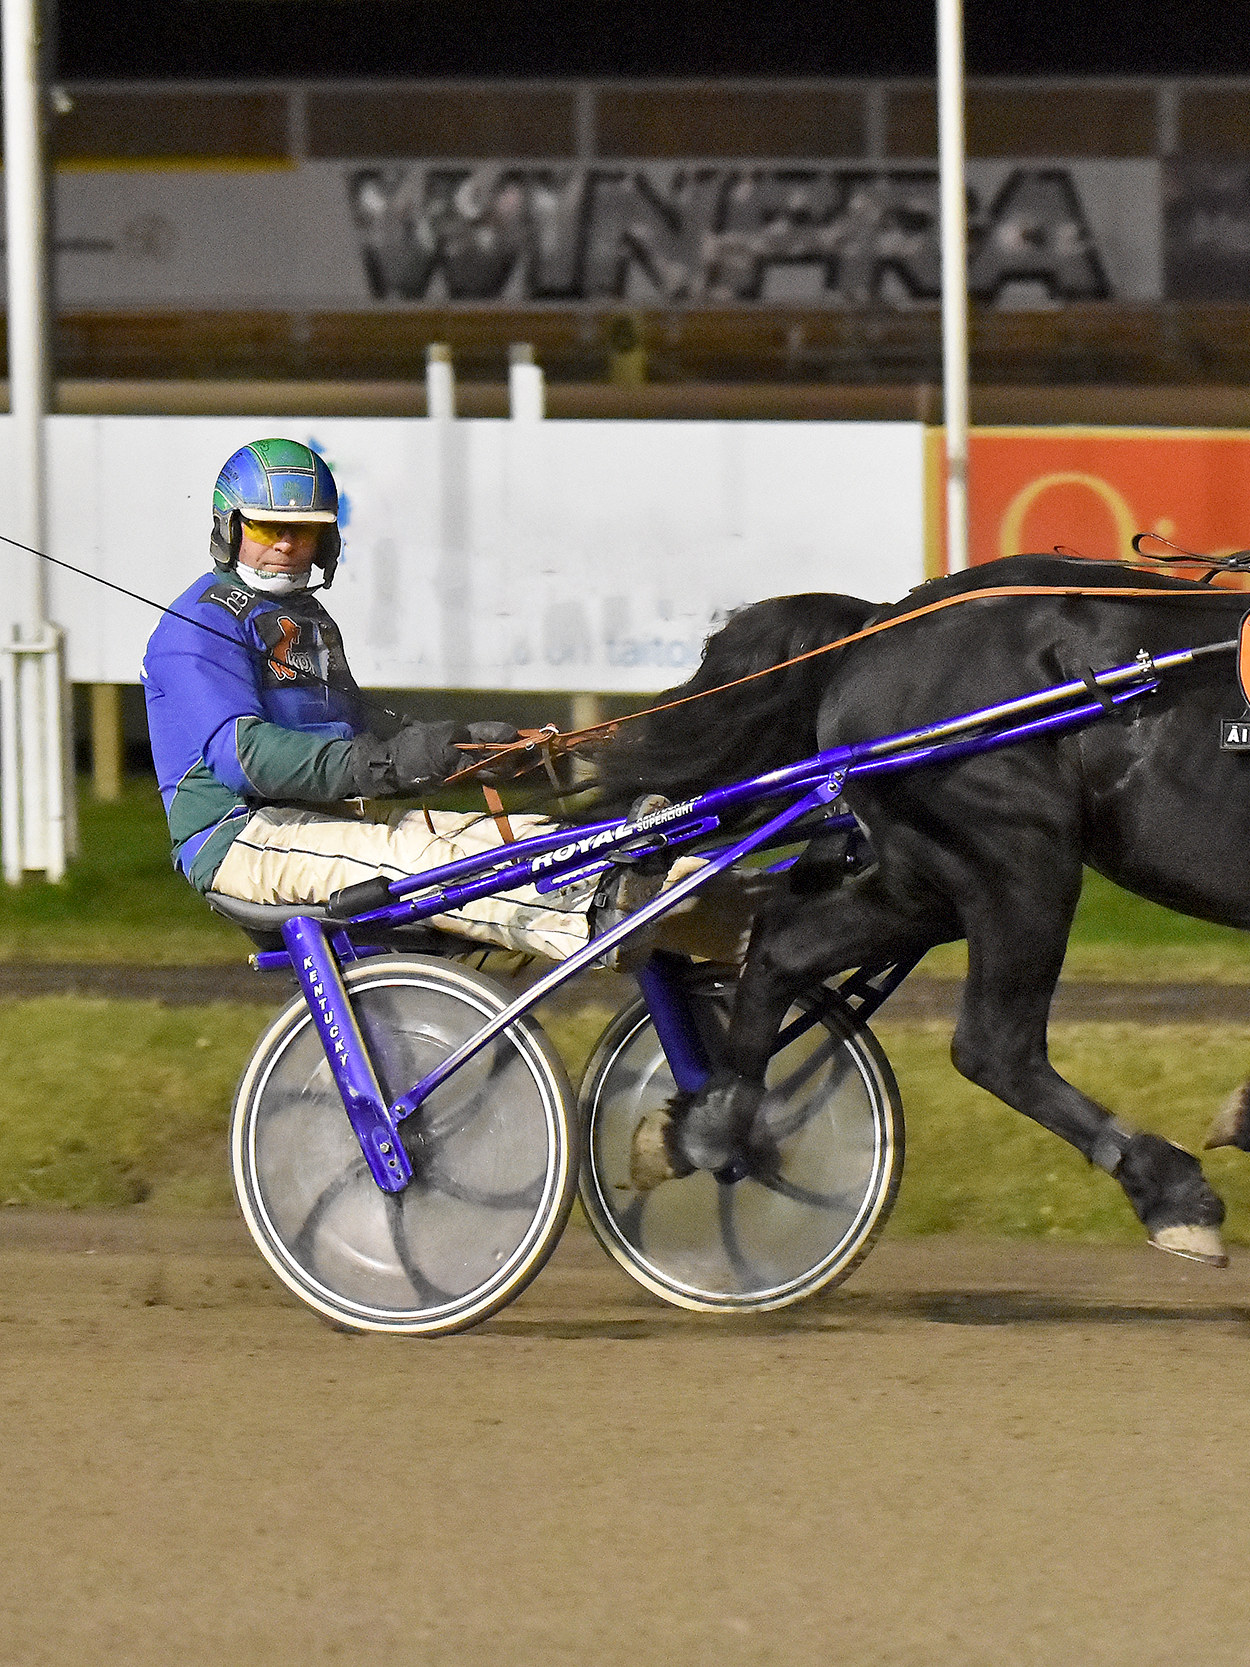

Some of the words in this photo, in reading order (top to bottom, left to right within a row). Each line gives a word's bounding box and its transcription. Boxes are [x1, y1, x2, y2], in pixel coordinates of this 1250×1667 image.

[636, 802, 696, 833] SUPERLIGHT
[531, 823, 635, 872] ROYAL
[303, 954, 349, 1067] KENTUCKY
